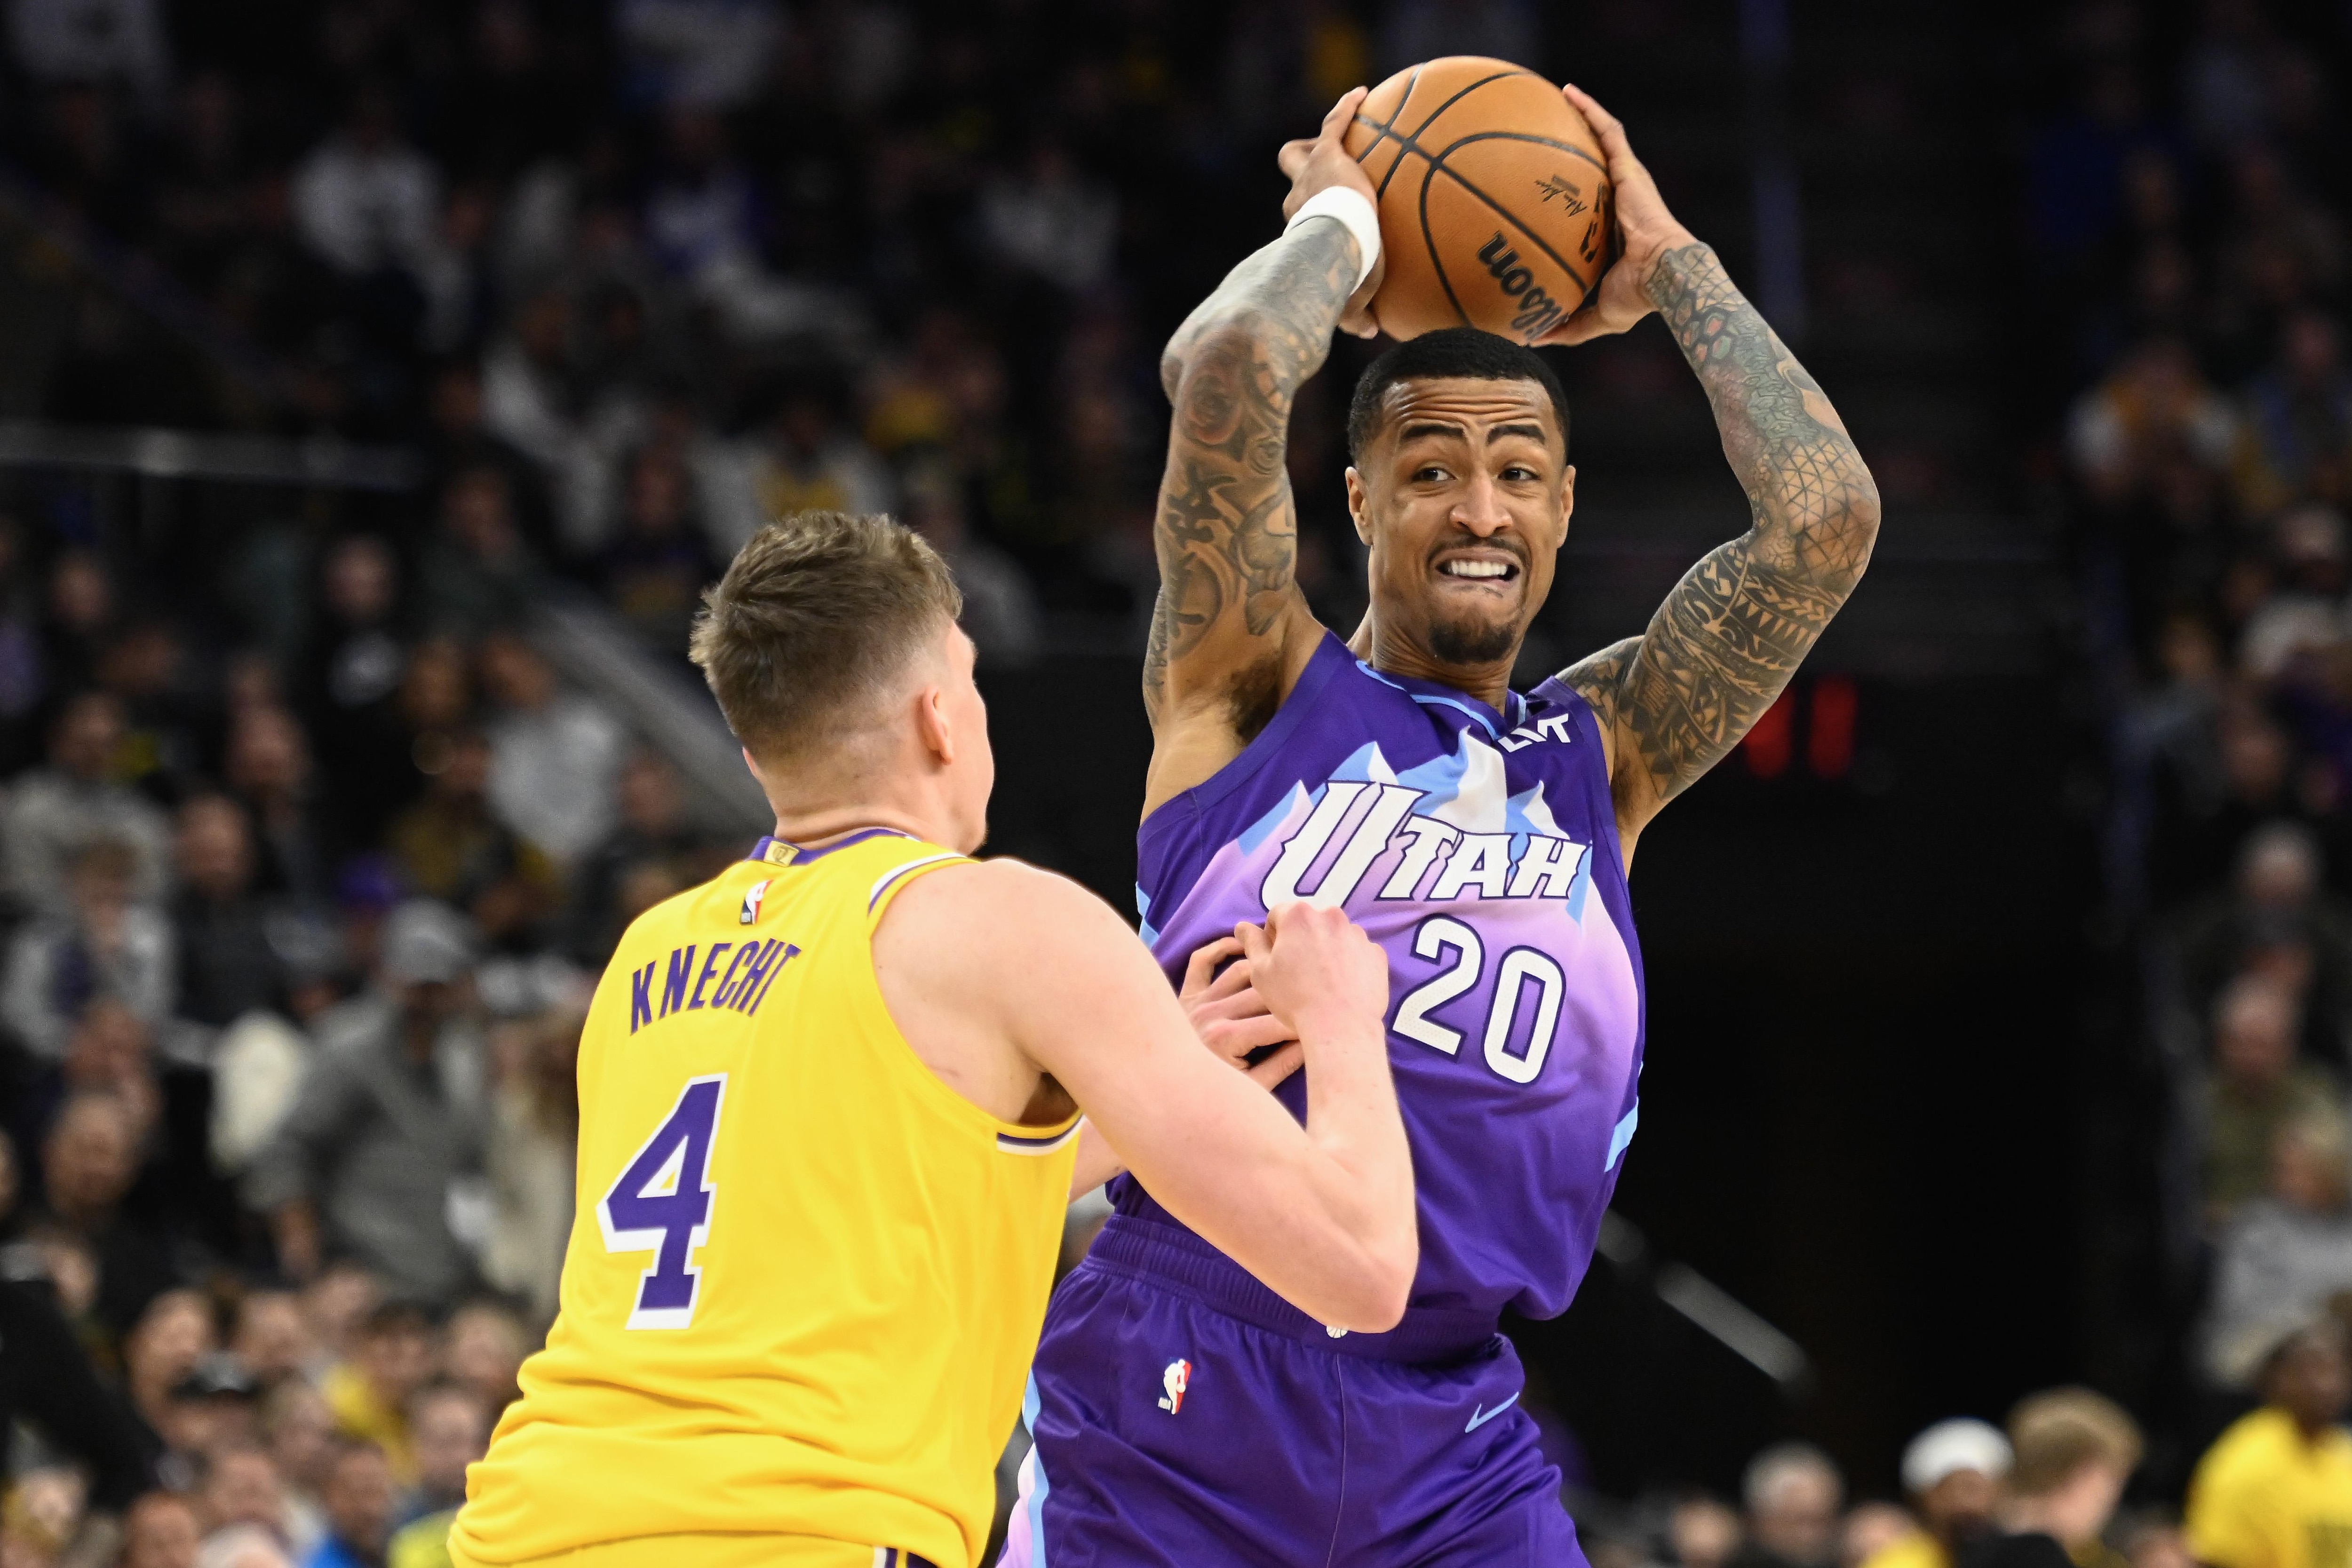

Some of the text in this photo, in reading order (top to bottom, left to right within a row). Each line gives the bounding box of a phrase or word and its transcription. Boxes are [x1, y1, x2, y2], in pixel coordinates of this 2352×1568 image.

[629, 938, 802, 1035] KNECHT
[1391, 913, 1567, 1087] 20
[595, 1072, 728, 1330] 4
